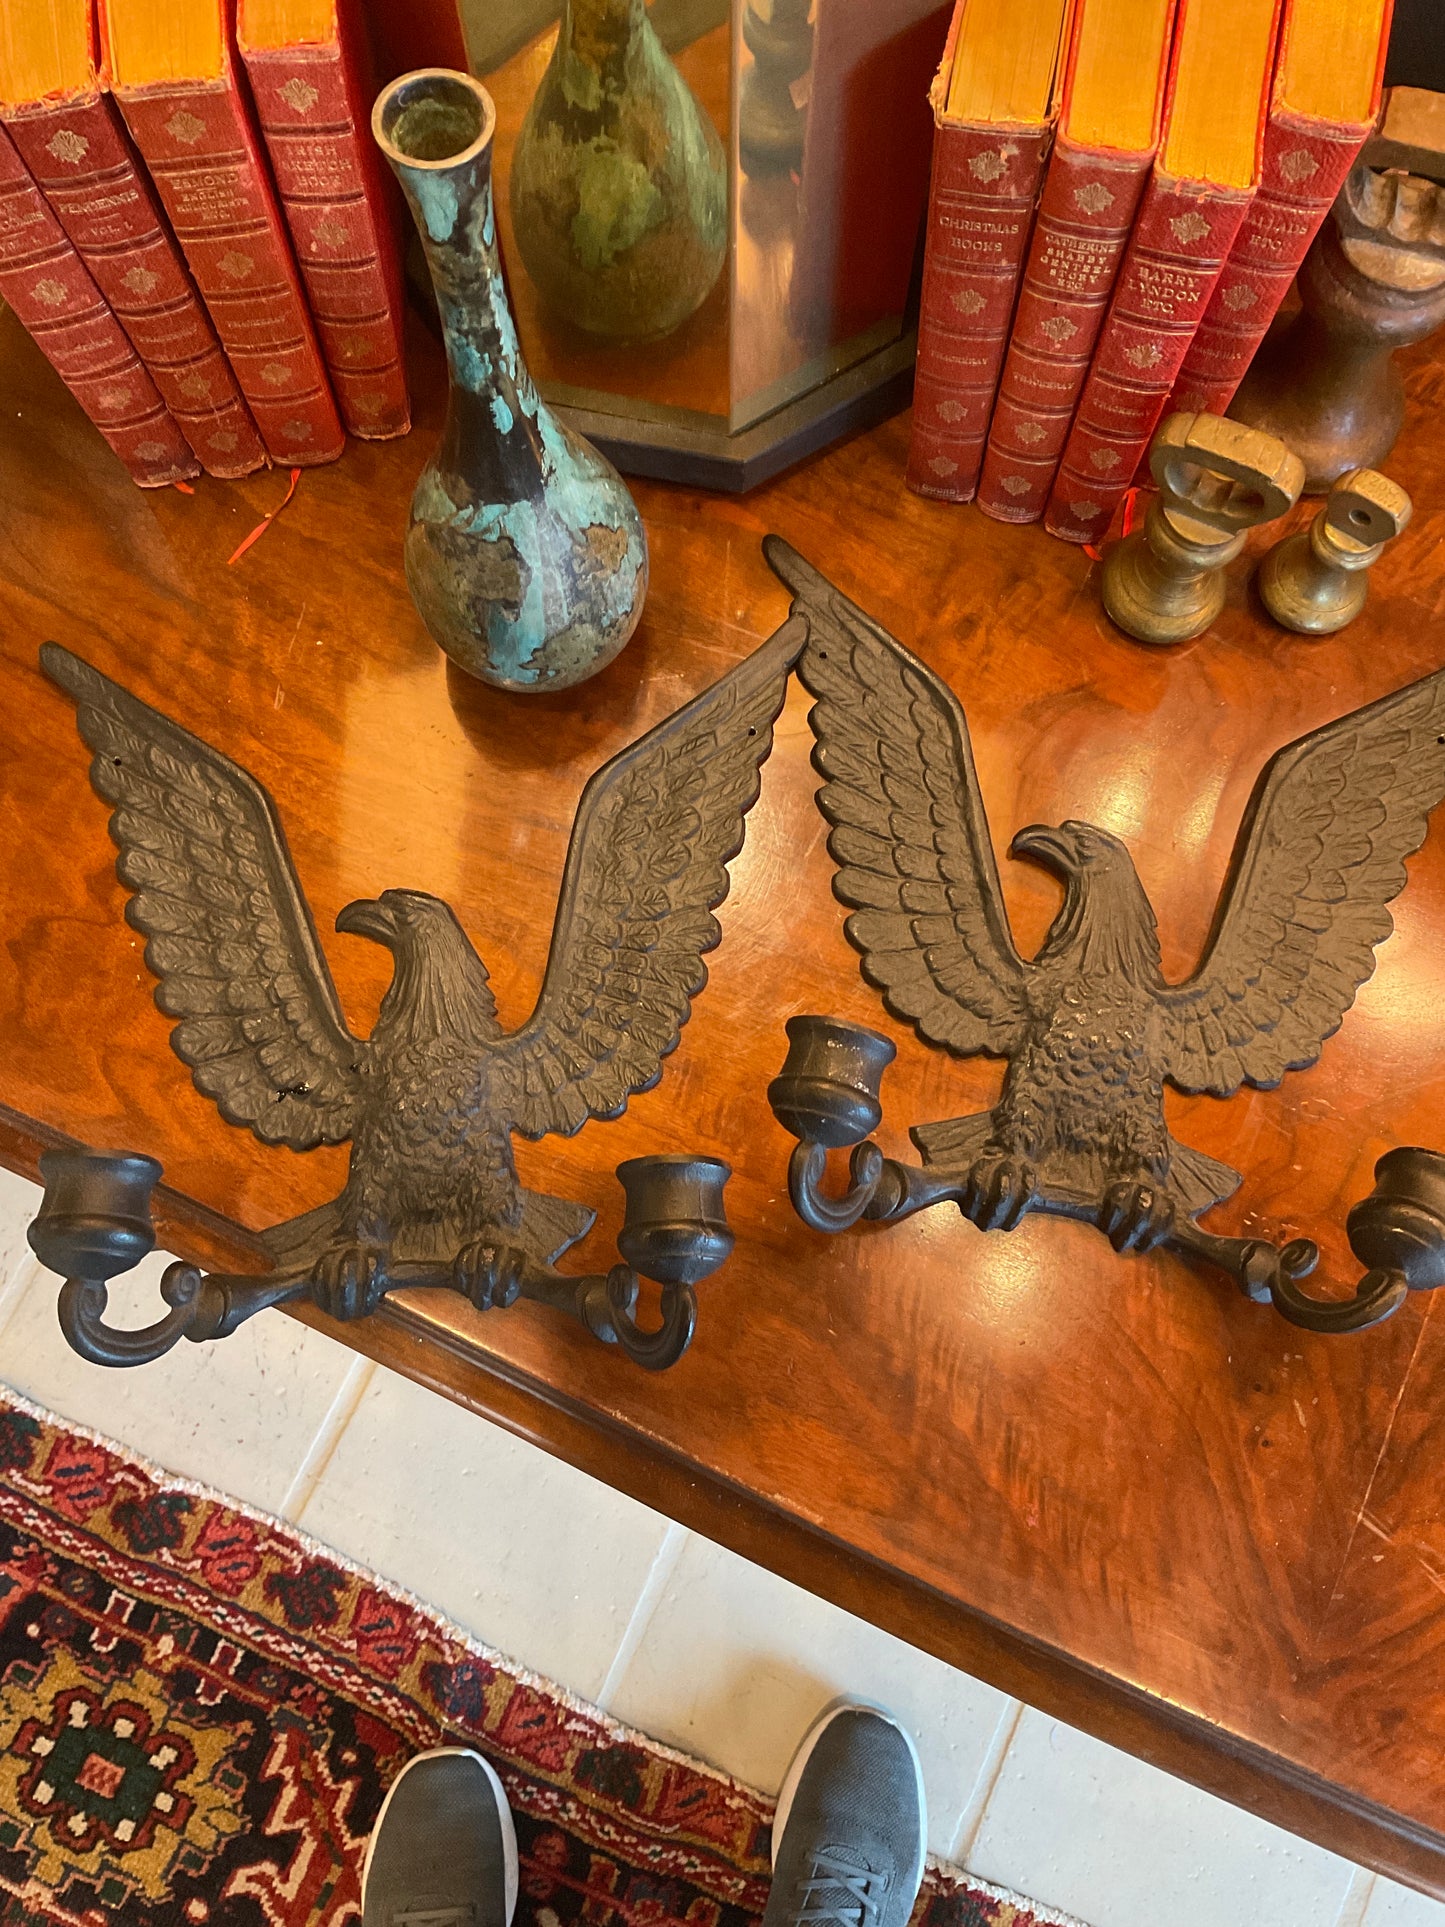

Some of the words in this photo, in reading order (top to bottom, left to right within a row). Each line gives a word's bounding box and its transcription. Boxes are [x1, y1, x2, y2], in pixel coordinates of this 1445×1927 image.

[170, 172, 239, 190] ESMOND
[59, 188, 139, 216] PENDENNIS
[940, 216, 1019, 235] CHRISTMAS
[951, 236, 1002, 252] BOOKS
[1045, 235, 1117, 254] CATHERINE
[1040, 255, 1111, 274] GENTEEL
[1047, 247, 1107, 265] SHABBY
[1049, 268, 1098, 284] STORY
[1138, 266, 1200, 288] BARRY
[1127, 278, 1200, 303] LYNDON
[1140, 298, 1174, 315] ETC.
